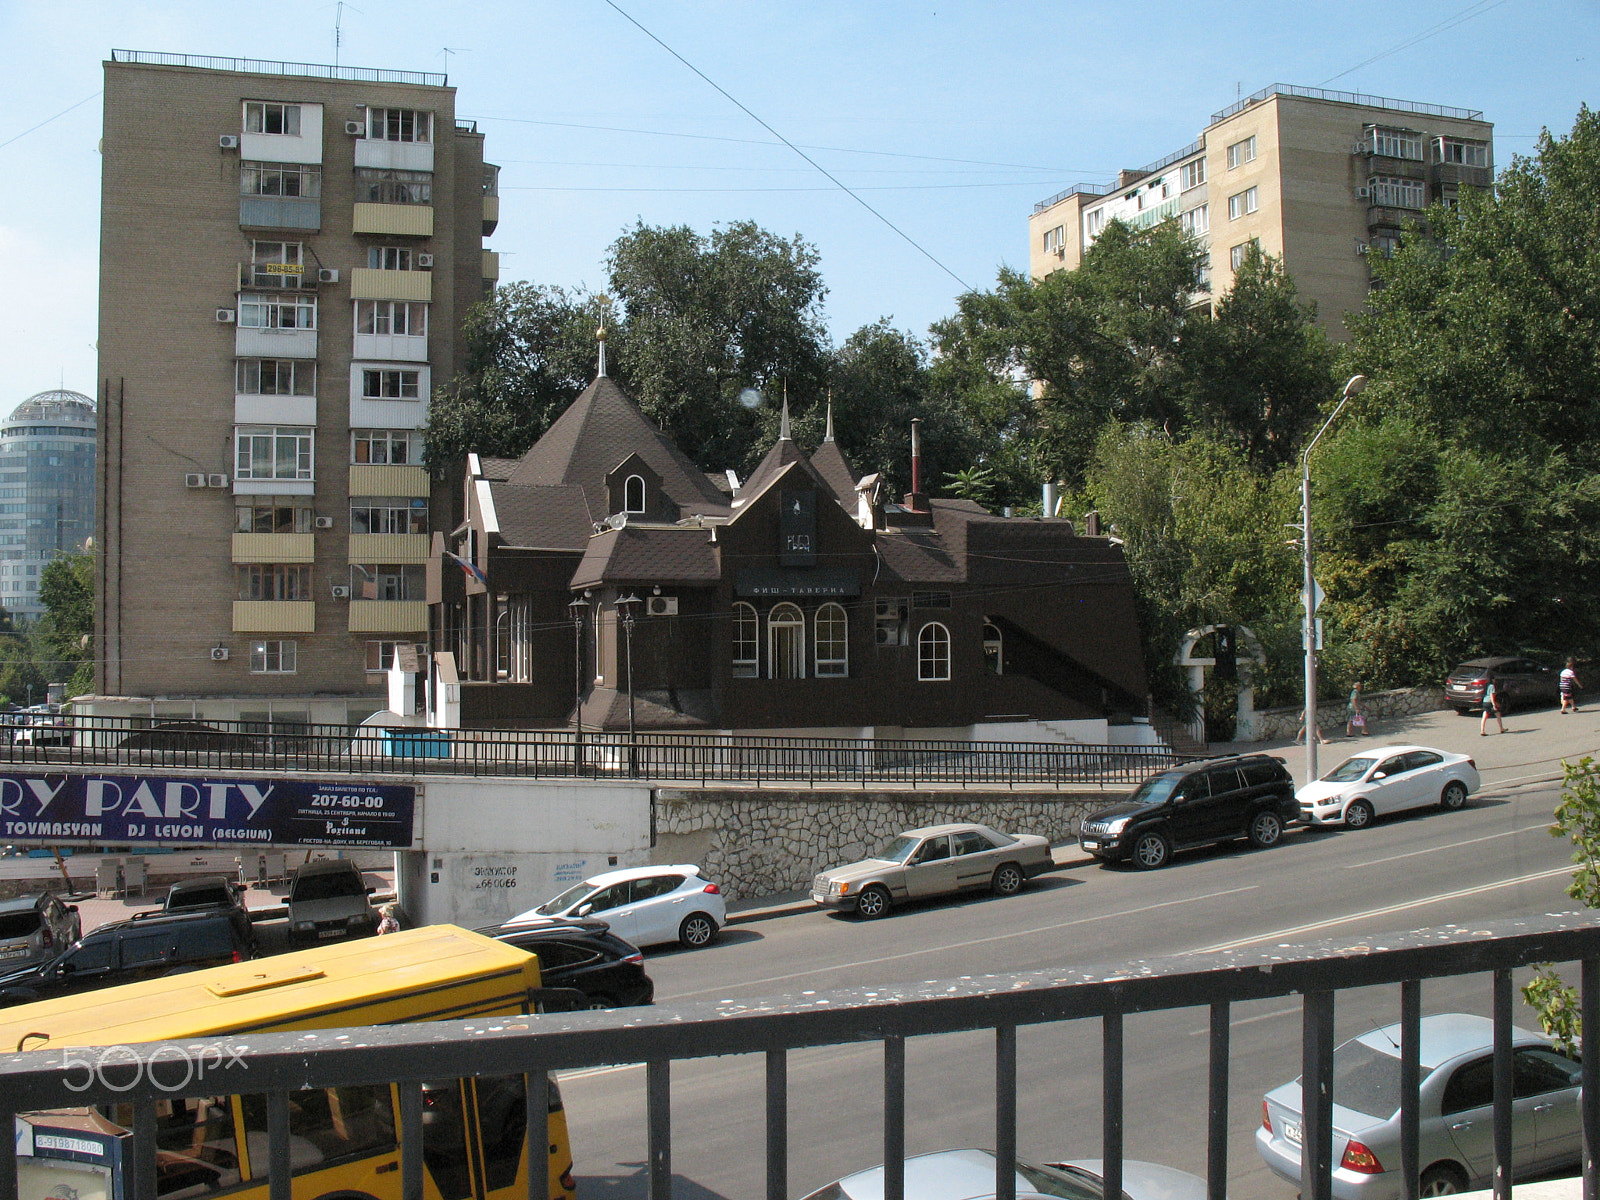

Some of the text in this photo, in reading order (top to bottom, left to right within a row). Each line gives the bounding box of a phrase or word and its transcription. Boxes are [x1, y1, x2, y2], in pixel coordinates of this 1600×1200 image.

[85, 780, 275, 820] PARTY
[311, 794, 383, 808] 207-60-00
[5, 821, 102, 837] TOVMASYAN
[128, 823, 273, 841] DJ LEVON (BELGIUM)
[326, 821, 366, 835] Portland
